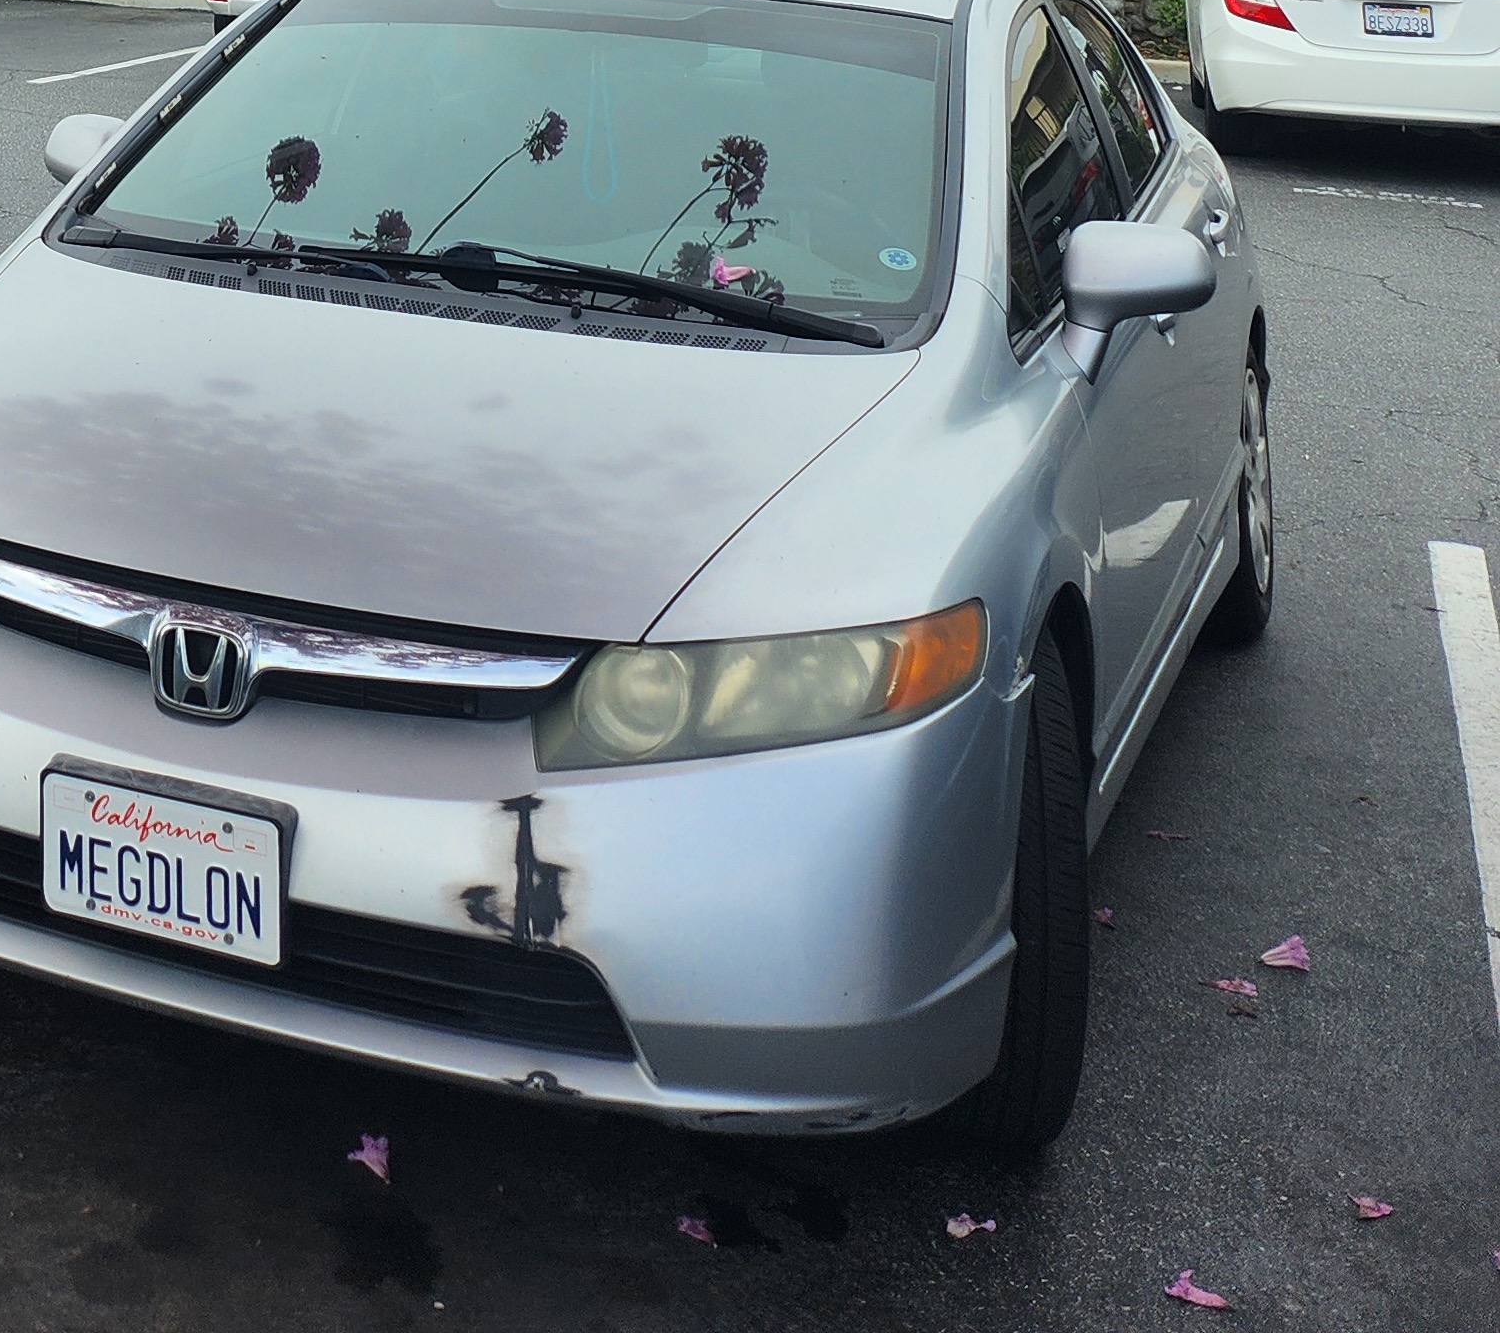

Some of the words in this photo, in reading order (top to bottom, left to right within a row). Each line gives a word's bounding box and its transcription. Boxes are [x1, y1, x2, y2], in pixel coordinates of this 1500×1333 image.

[1368, 14, 1429, 32] 8ESZ338
[91, 794, 235, 853] California
[59, 829, 261, 940] MEGDLON
[100, 902, 219, 942] dmv.ca.gov
